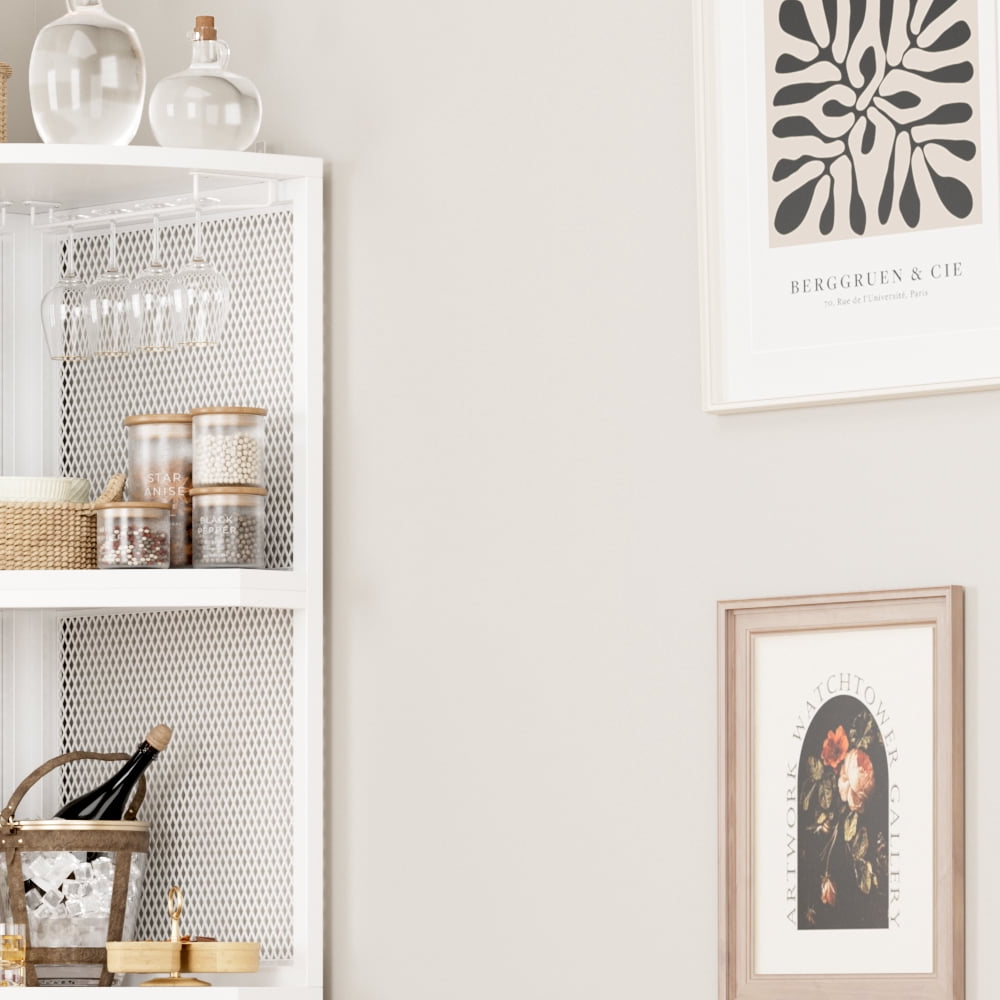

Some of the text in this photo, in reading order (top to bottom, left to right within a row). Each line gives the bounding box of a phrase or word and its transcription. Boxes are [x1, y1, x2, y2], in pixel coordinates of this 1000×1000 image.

[791, 262, 964, 295] BERGGRUEN & CIE
[837, 297, 851, 307] Rue
[852, 295, 862, 305] de
[910, 288, 929, 299] Paris
[147, 472, 182, 483] STAR
[144, 486, 185, 497] ANISE
[199, 514, 233, 525] BLACK
[197, 526, 237, 536] PEPPER
[786, 672, 901, 928] ARTWORK WATCHTOWER GALLERY
